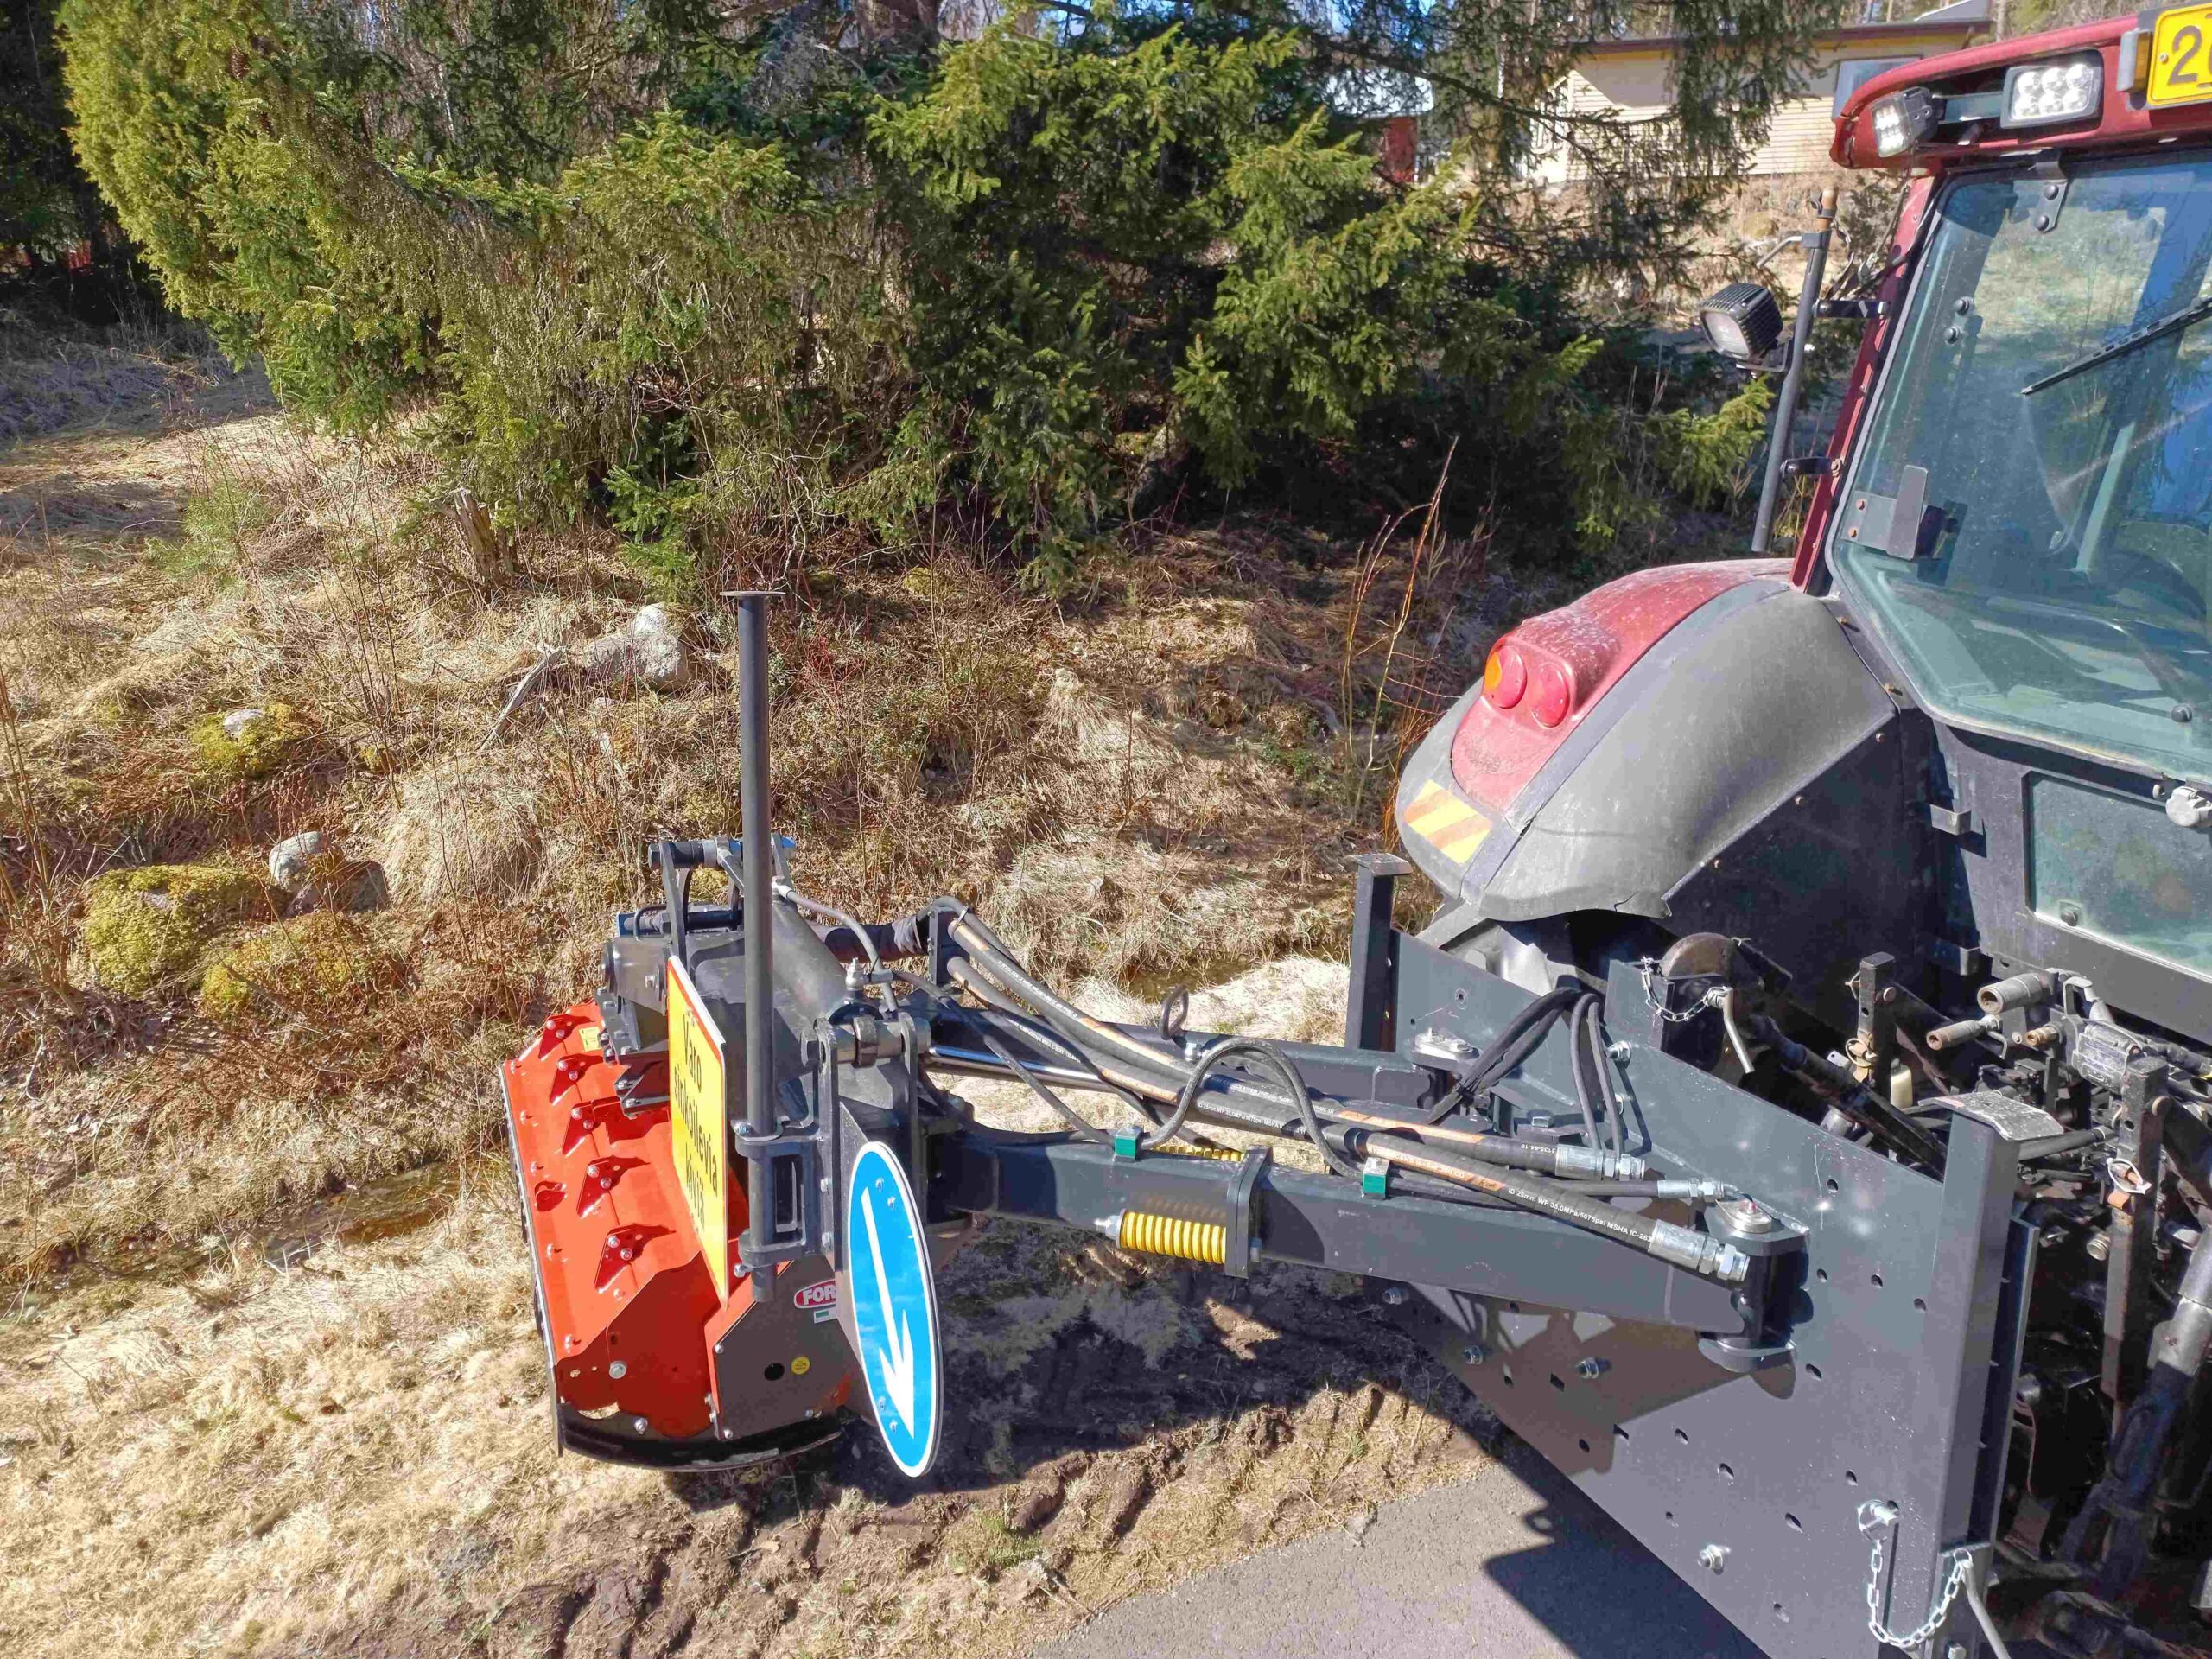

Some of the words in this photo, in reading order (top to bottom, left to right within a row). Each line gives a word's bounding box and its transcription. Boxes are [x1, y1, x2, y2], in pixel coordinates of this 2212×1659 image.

[2167, 23, 2212, 86] 2
[683, 1014, 702, 1094] Varo
[674, 1062, 718, 1198] sinkoilevia
[685, 1141, 705, 1232] kiviä
[1516, 1190, 1536, 1203] 25mm
[1537, 1195, 1549, 1206] WP
[1607, 1221, 1629, 1235] MSHA
